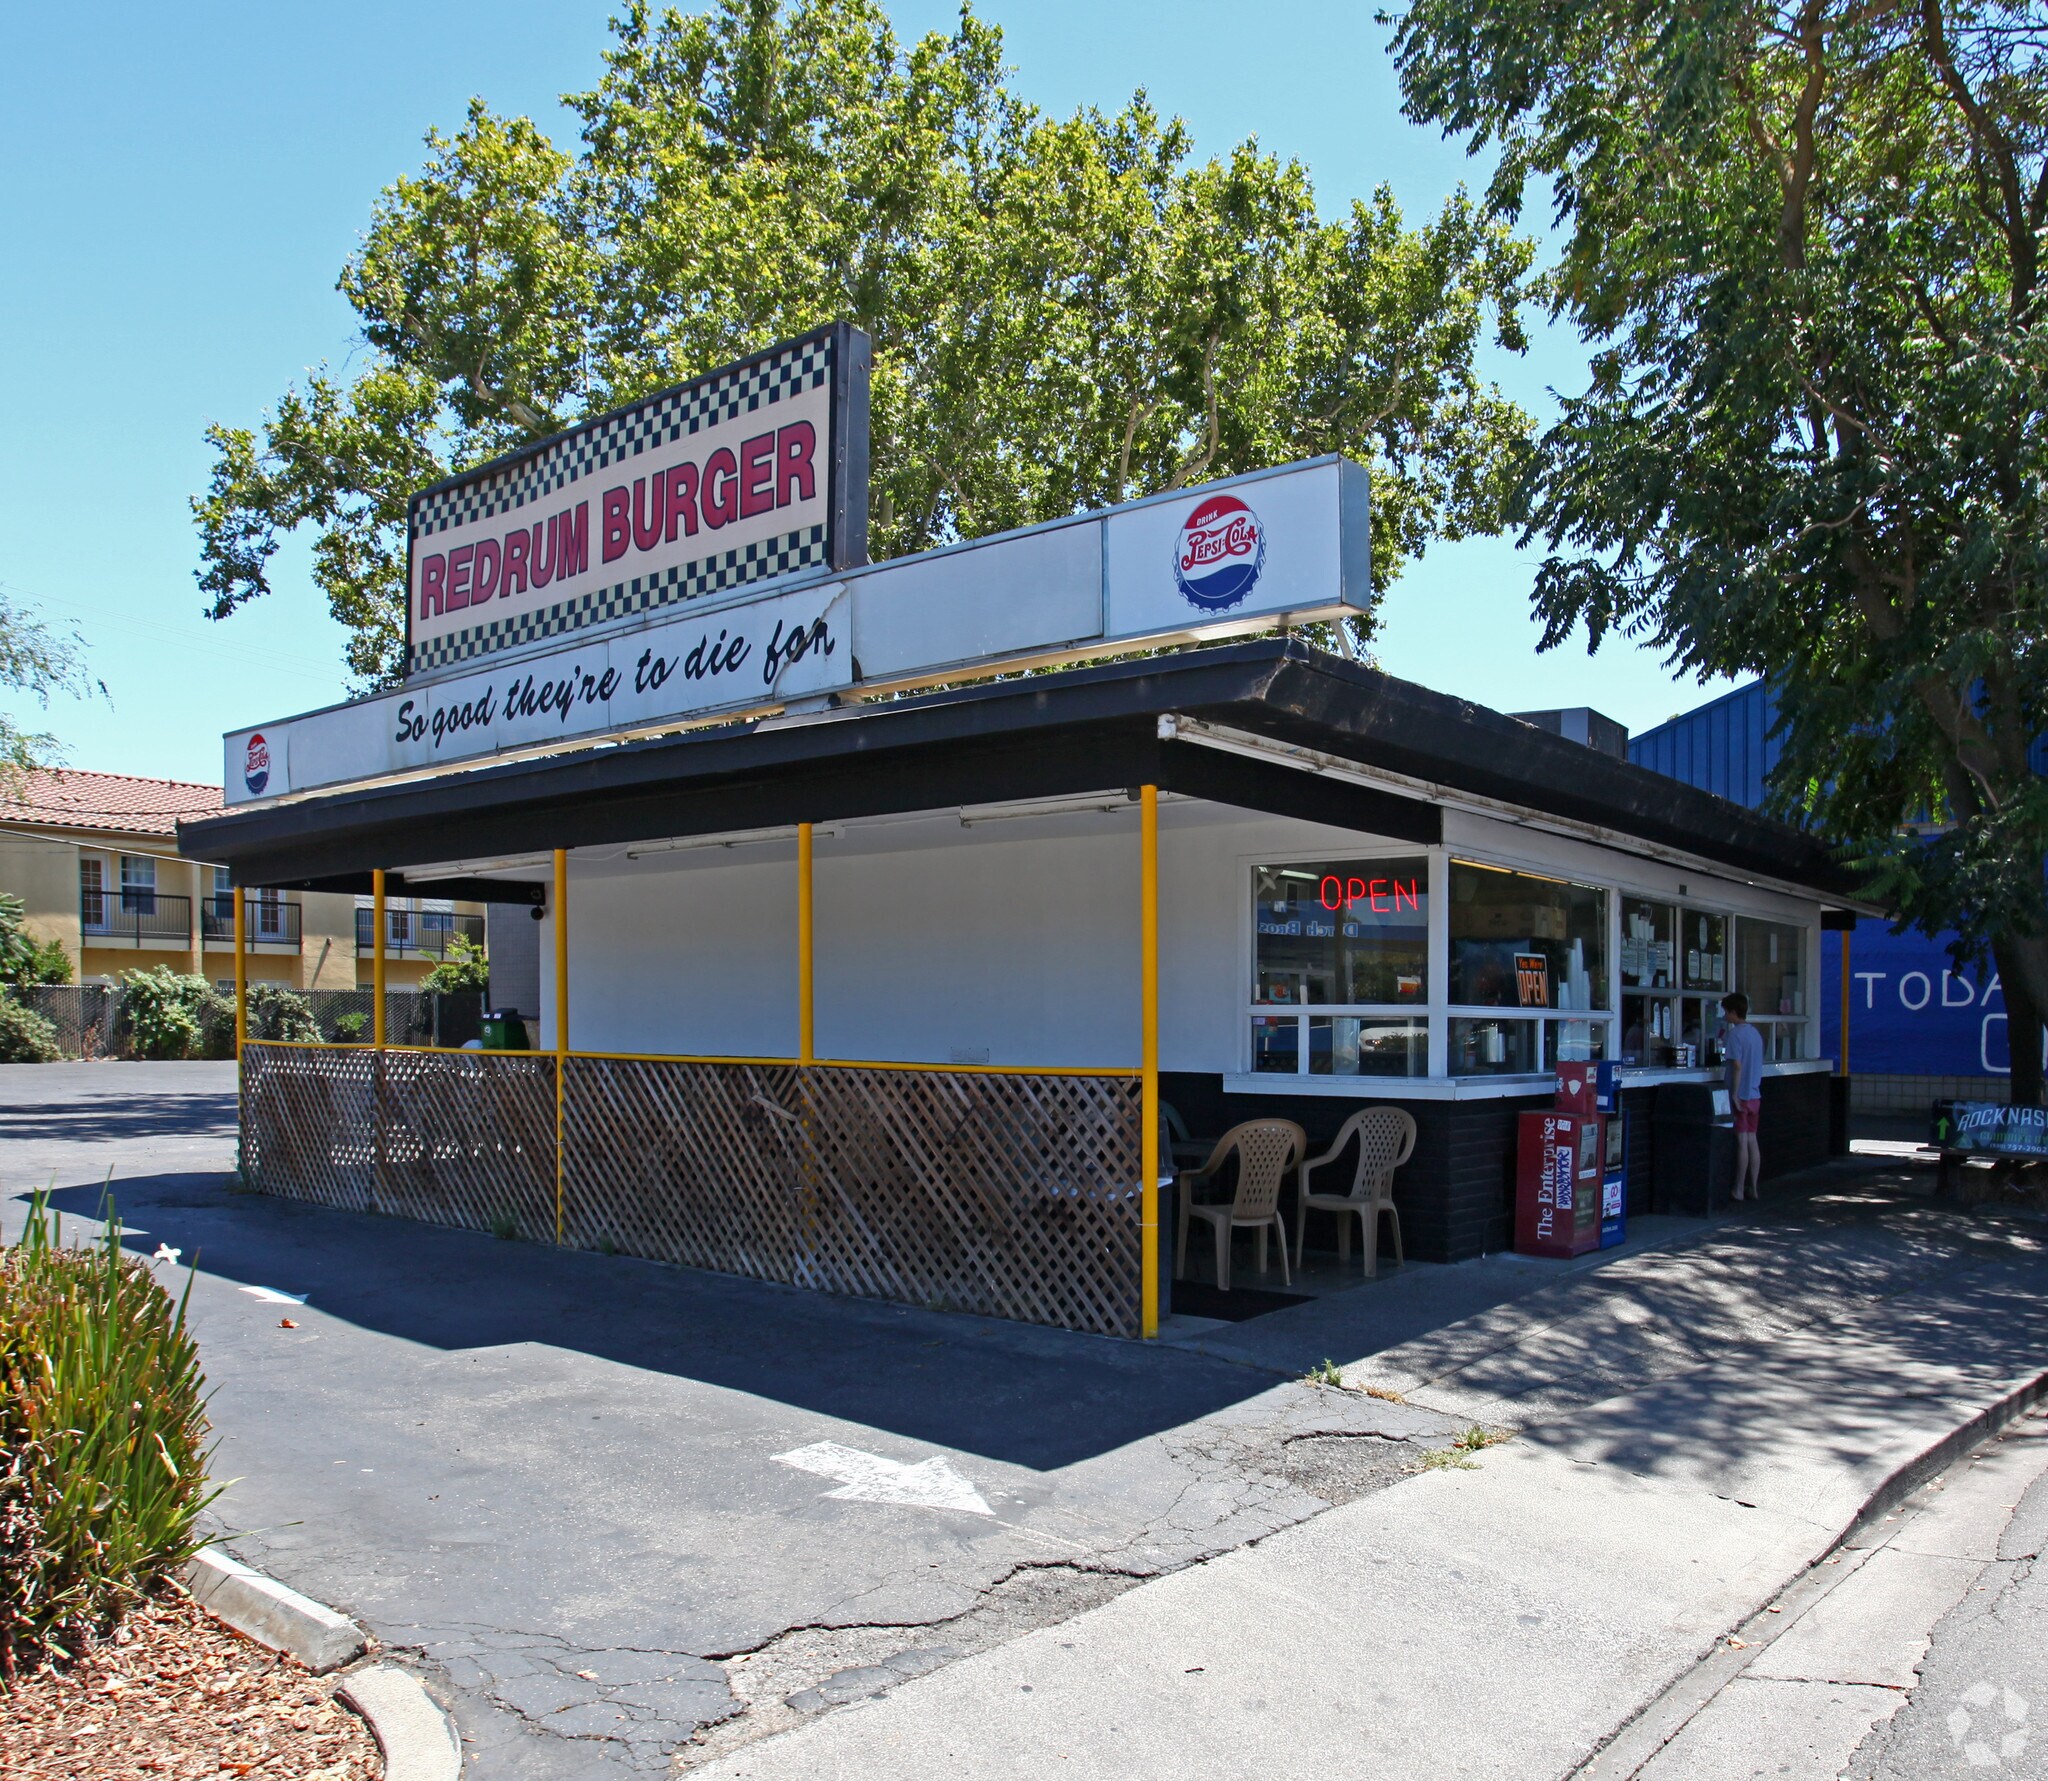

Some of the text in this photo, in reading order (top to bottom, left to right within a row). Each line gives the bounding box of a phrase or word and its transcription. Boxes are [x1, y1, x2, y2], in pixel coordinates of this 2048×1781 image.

[420, 420, 816, 620] REDRUM BURGER
[1196, 510, 1218, 526] DRINK
[395, 617, 835, 748] So good they're to die for
[1320, 875, 1418, 912] OPEN
[1518, 970, 1547, 1005] OPEN
[1957, 1105, 2048, 1132] ROCKNAS
[1537, 1117, 1556, 1240] The Enterprise
